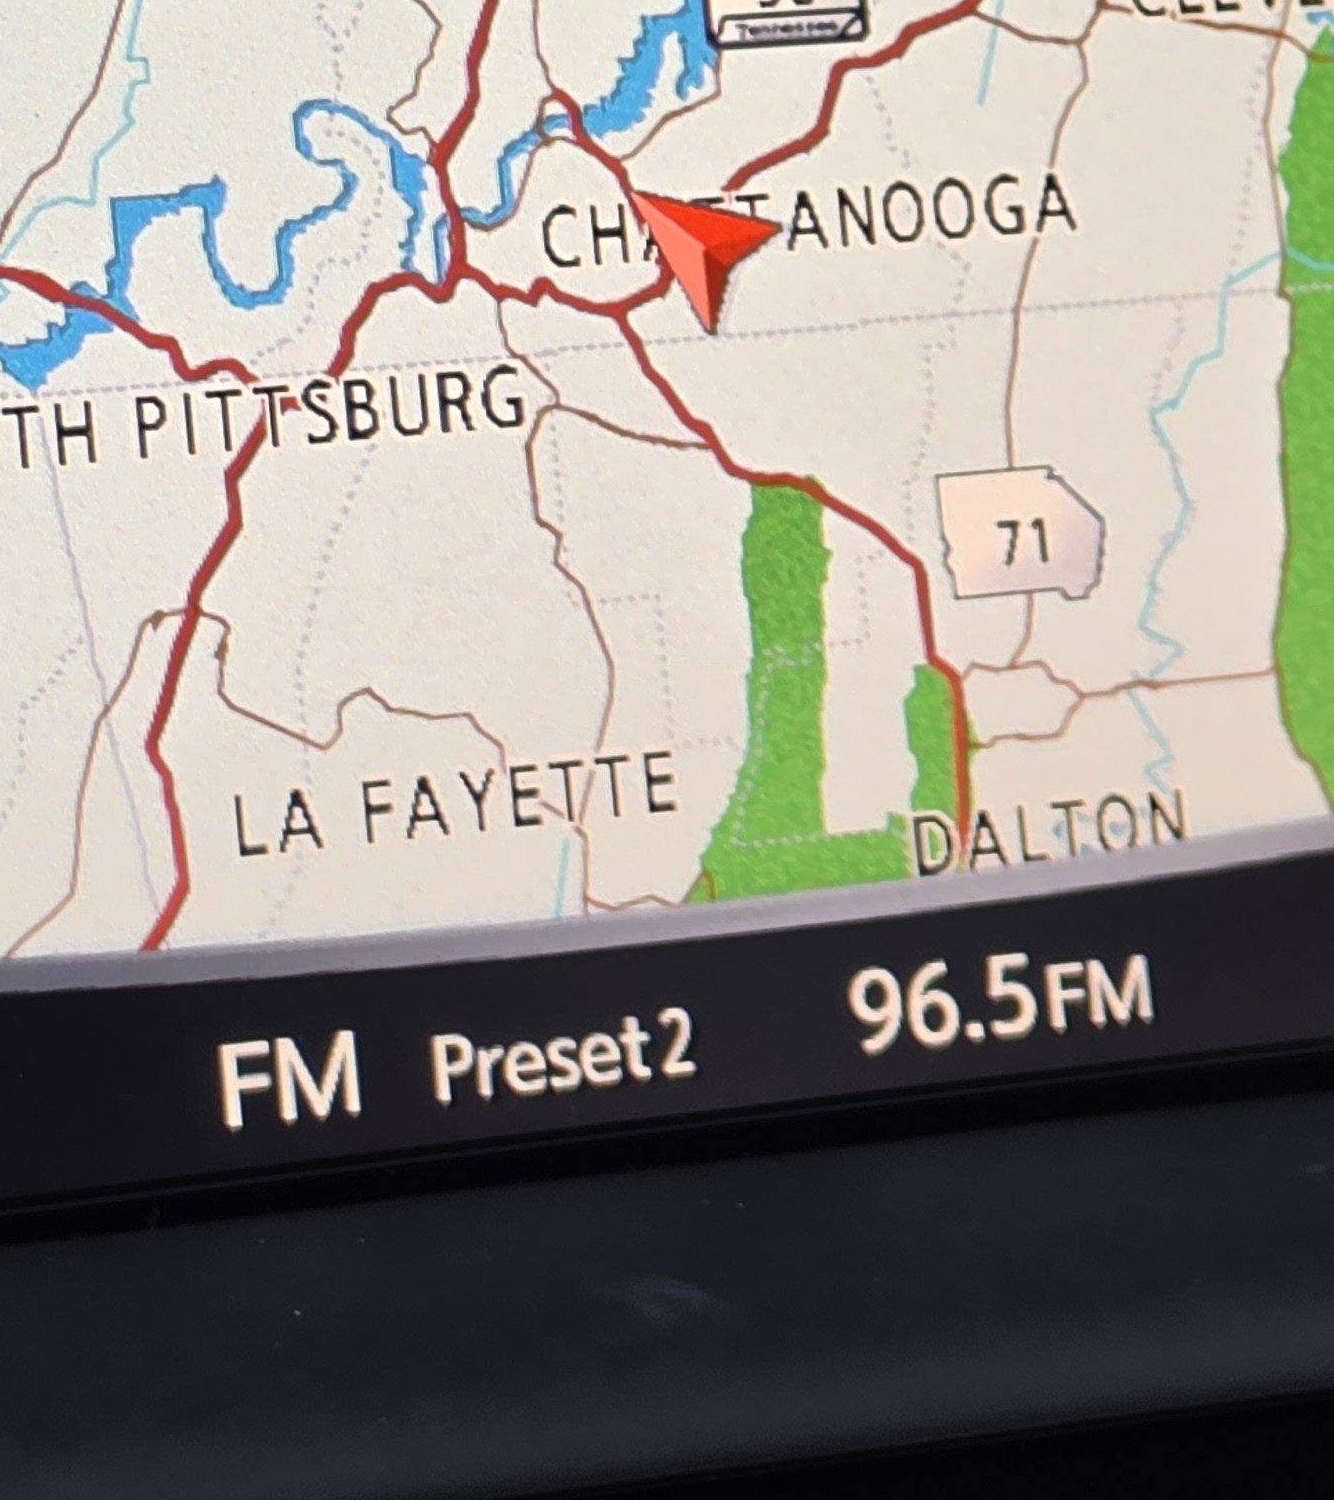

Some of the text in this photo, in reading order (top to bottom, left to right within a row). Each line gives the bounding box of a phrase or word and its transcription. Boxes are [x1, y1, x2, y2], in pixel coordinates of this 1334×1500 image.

[135, 366, 525, 460] PITTSBURG
[997, 517, 1049, 565] 71
[234, 751, 678, 857] LA FAYETTE
[913, 789, 1187, 876] DALTON
[217, 1028, 362, 1132] FM
